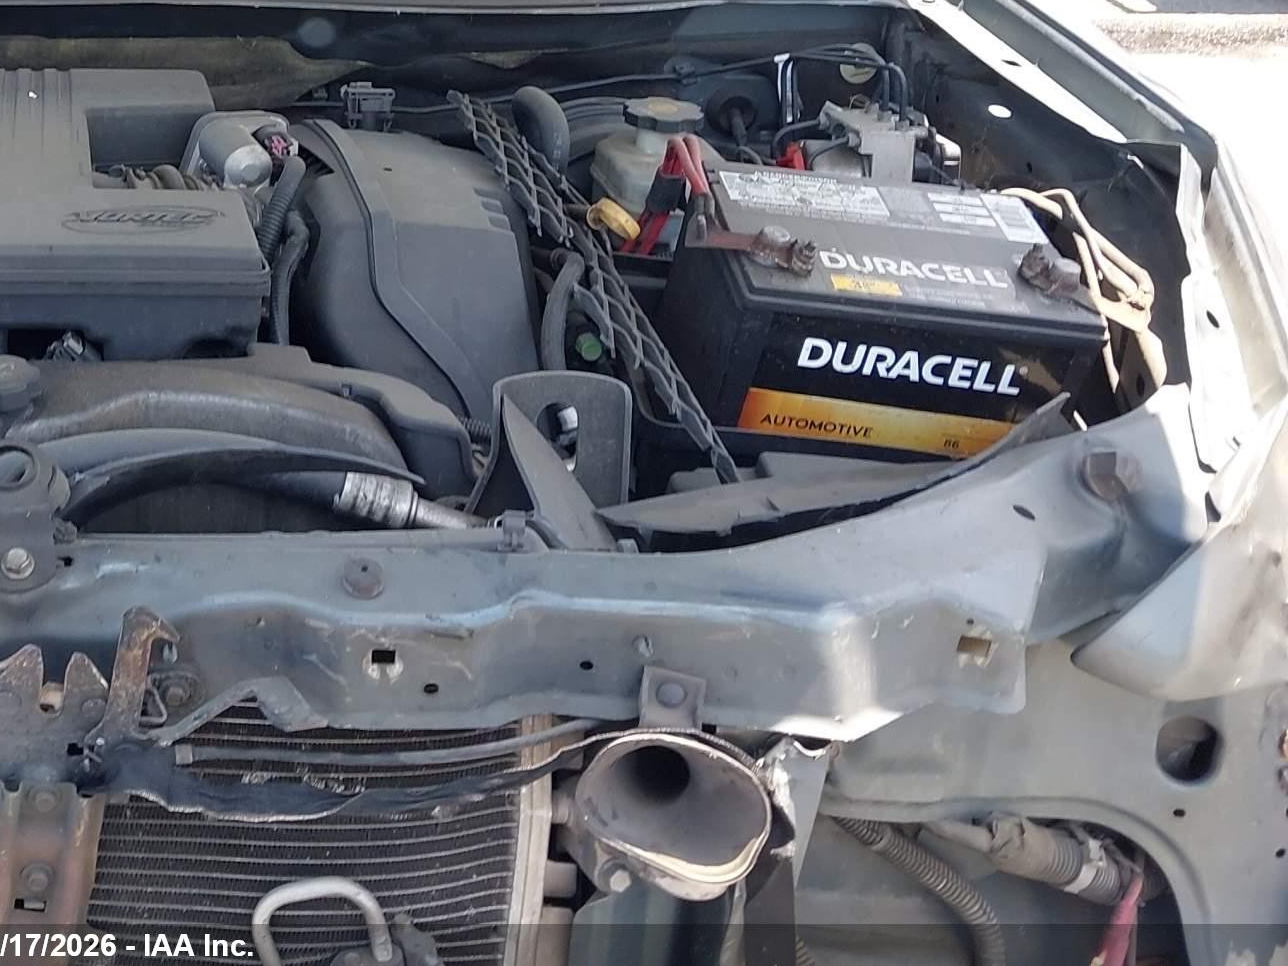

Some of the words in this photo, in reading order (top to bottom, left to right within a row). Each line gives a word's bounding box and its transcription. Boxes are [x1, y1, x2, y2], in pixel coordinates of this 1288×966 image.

[819, 250, 1009, 289] DURACELL
[797, 337, 1021, 396] DURACELL
[759, 413, 874, 439] AUTOMOTIVE
